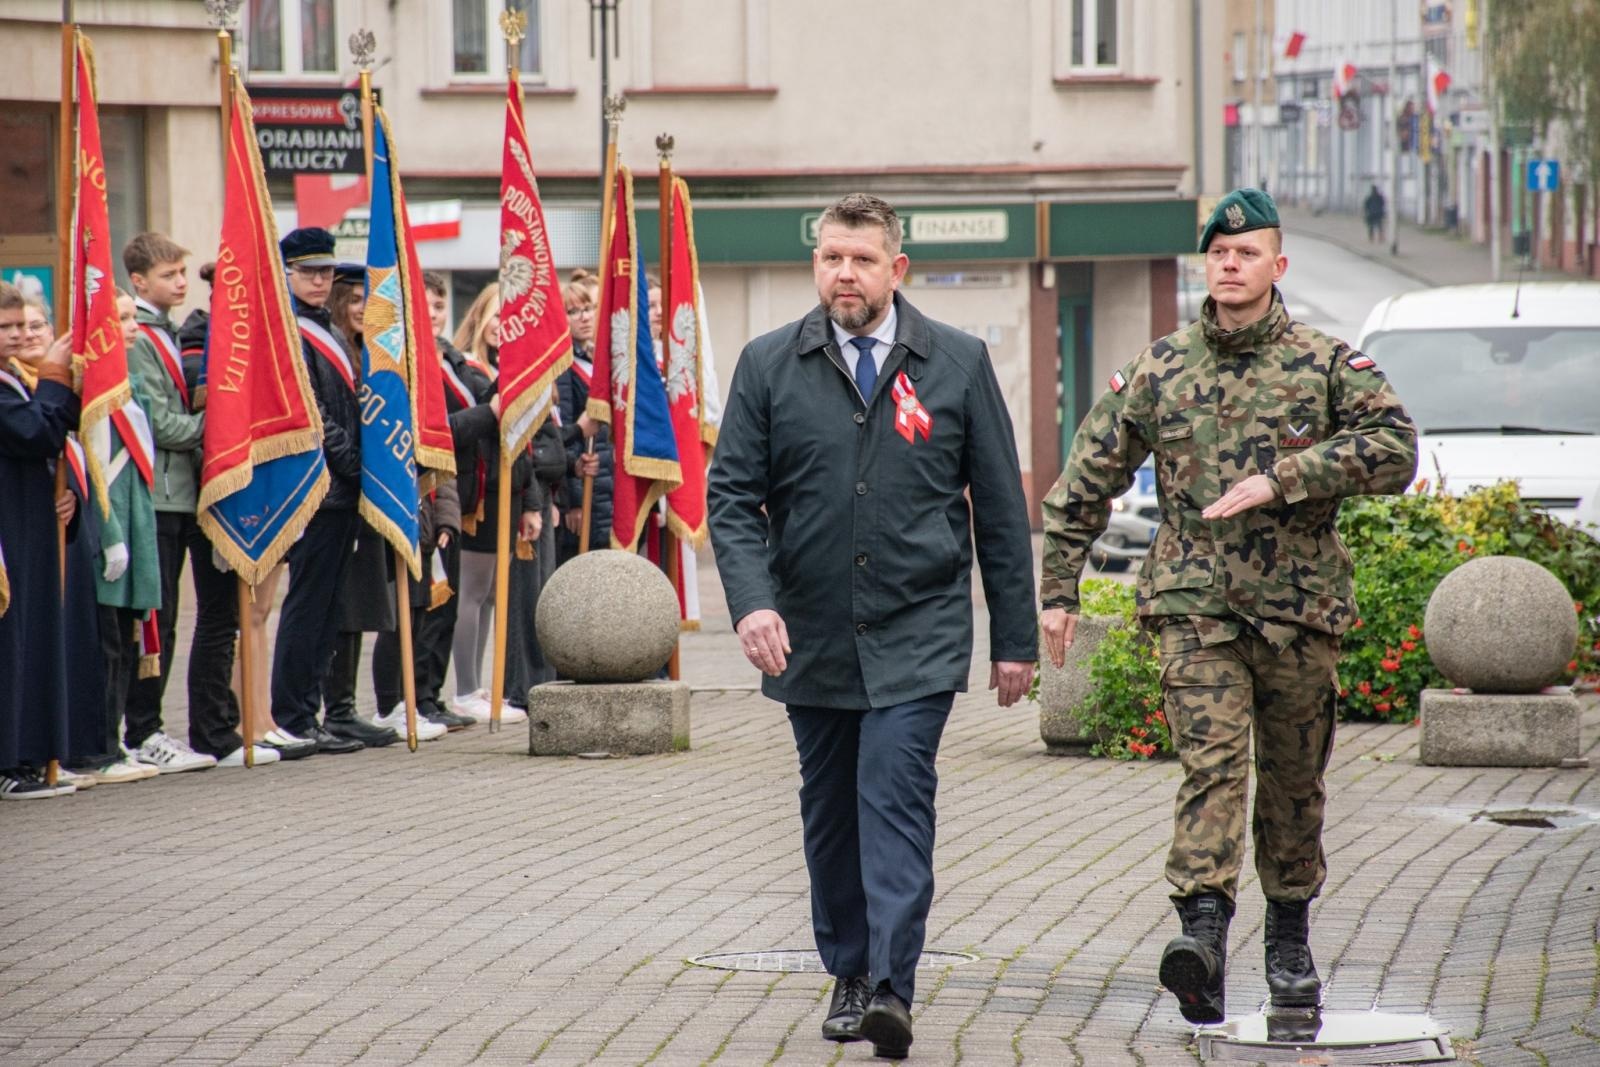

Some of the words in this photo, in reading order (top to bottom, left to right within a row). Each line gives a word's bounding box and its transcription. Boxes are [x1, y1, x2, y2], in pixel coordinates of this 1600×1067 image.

[252, 104, 335, 118] KPRESOWE
[258, 129, 362, 149] ORABIANI
[269, 151, 348, 169] KLUCZY
[502, 185, 550, 286] PODSTAWOWA
[917, 219, 996, 235] FINANSE
[217, 239, 251, 394] POSPOLITA
